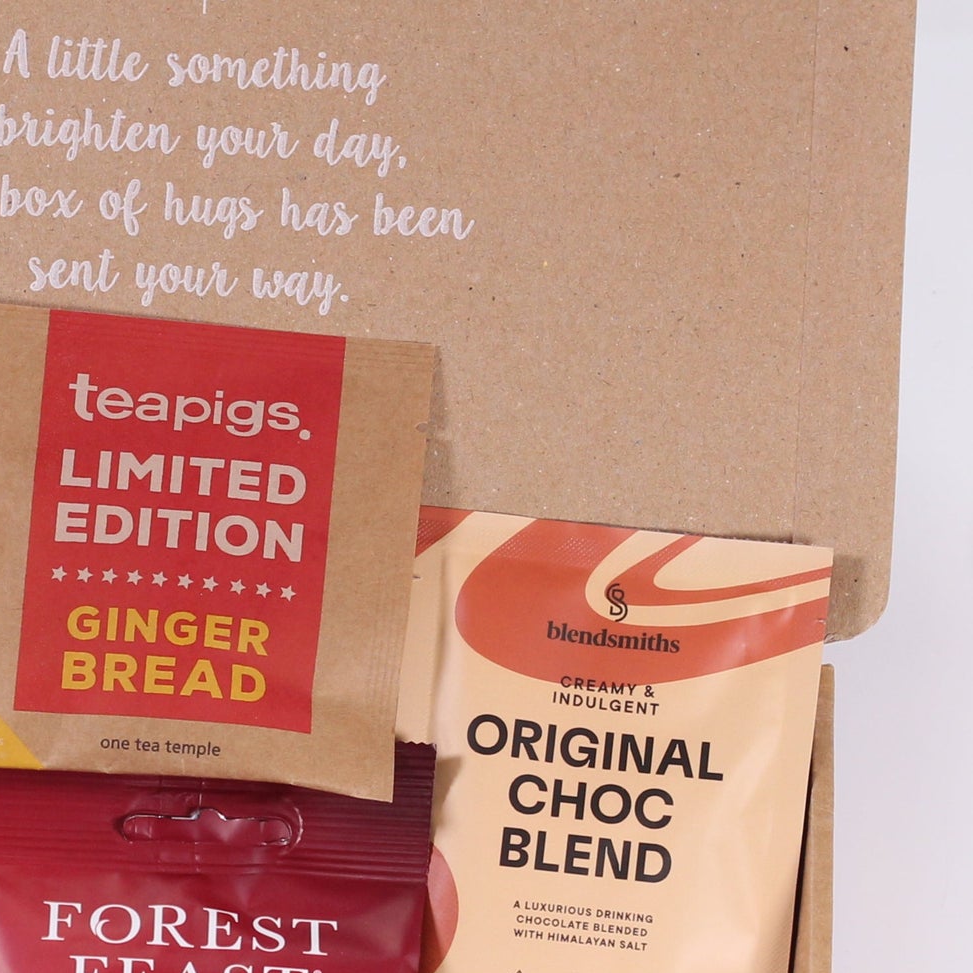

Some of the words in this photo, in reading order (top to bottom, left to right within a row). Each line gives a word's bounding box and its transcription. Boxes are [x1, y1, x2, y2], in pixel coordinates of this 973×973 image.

[2, 28, 30, 78] A
[46, 34, 149, 82] little
[166, 46, 386, 105] something
[196, 122, 299, 169] your
[313, 119, 407, 177] day,
[0, 174, 84, 218] box
[99, 179, 147, 237] of
[165, 182, 264, 239] hugs
[281, 188, 358, 237] has
[372, 193, 475, 240] been
[28, 249, 120, 292] sent
[135, 259, 238, 306] your
[253, 268, 350, 315] way.
[69, 373, 311, 440] teapigs.
[60, 449, 307, 504] LIMITED
[54, 502, 303, 562] EDITION
[66, 606, 270, 656] GINGER
[546, 620, 680, 654] blendsmiths
[61, 651, 266, 702] BREAD
[552, 692, 660, 715] INDULGENT
[560, 676, 637, 696] CREAMY
[644, 684, 655, 698] &
[100, 737, 129, 751] one
[134, 737, 160, 753] tea
[165, 739, 221, 758] temple
[466, 714, 724, 781] ORIGINAL
[508, 774, 674, 829] CHOC
[499, 827, 673, 883] BLEND
[41, 901, 338, 956] FOREST
[513, 900, 521, 909] A
[524, 901, 592, 916] LUXURIOUS
[596, 909, 653, 923] DRINKING
[516, 915, 589, 930] CHOCOLATE
[593, 923, 647, 936] BLENDED
[514, 929, 543, 939] WITH
[548, 932, 615, 947] HIMALAYAN
[619, 940, 648, 951] SALT
